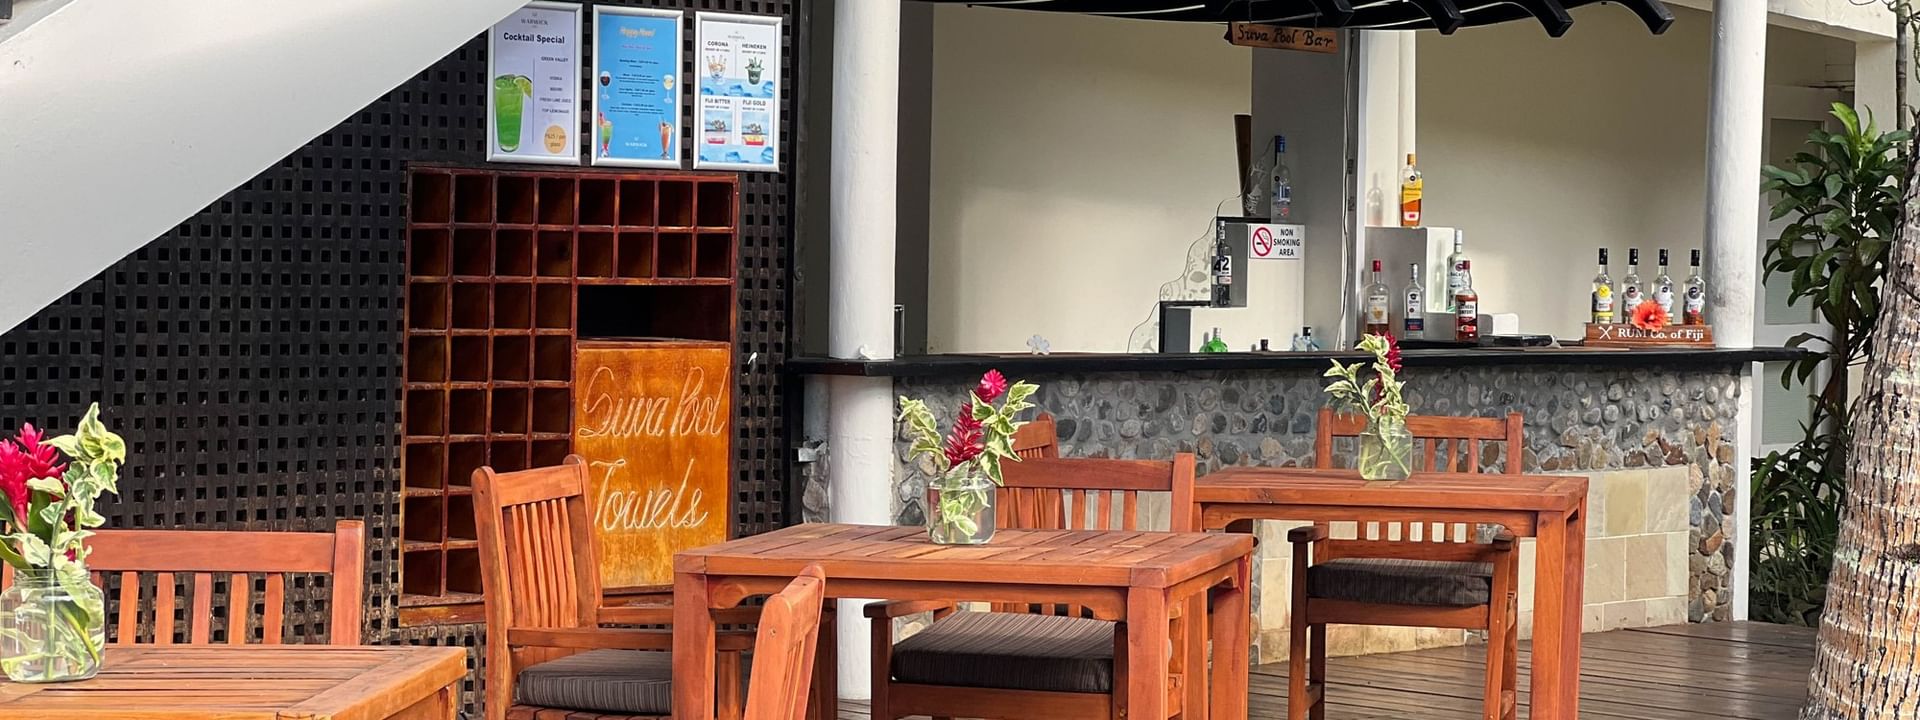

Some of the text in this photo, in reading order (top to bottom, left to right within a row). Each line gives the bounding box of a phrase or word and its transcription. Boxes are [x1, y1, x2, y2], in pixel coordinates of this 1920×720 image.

[503, 32, 565, 44] Cocktail Special
[1237, 24, 1334, 48] Suva Pool Bar
[1280, 228, 1294, 237] NON
[1273, 238, 1301, 247] SMOKING
[1279, 248, 1295, 257] AREA
[1213, 256, 1230, 272] 42
[1617, 327, 1704, 342] RUM Co. of Fiji
[578, 366, 730, 438] Suva Pool
[589, 457, 709, 532] Towels
